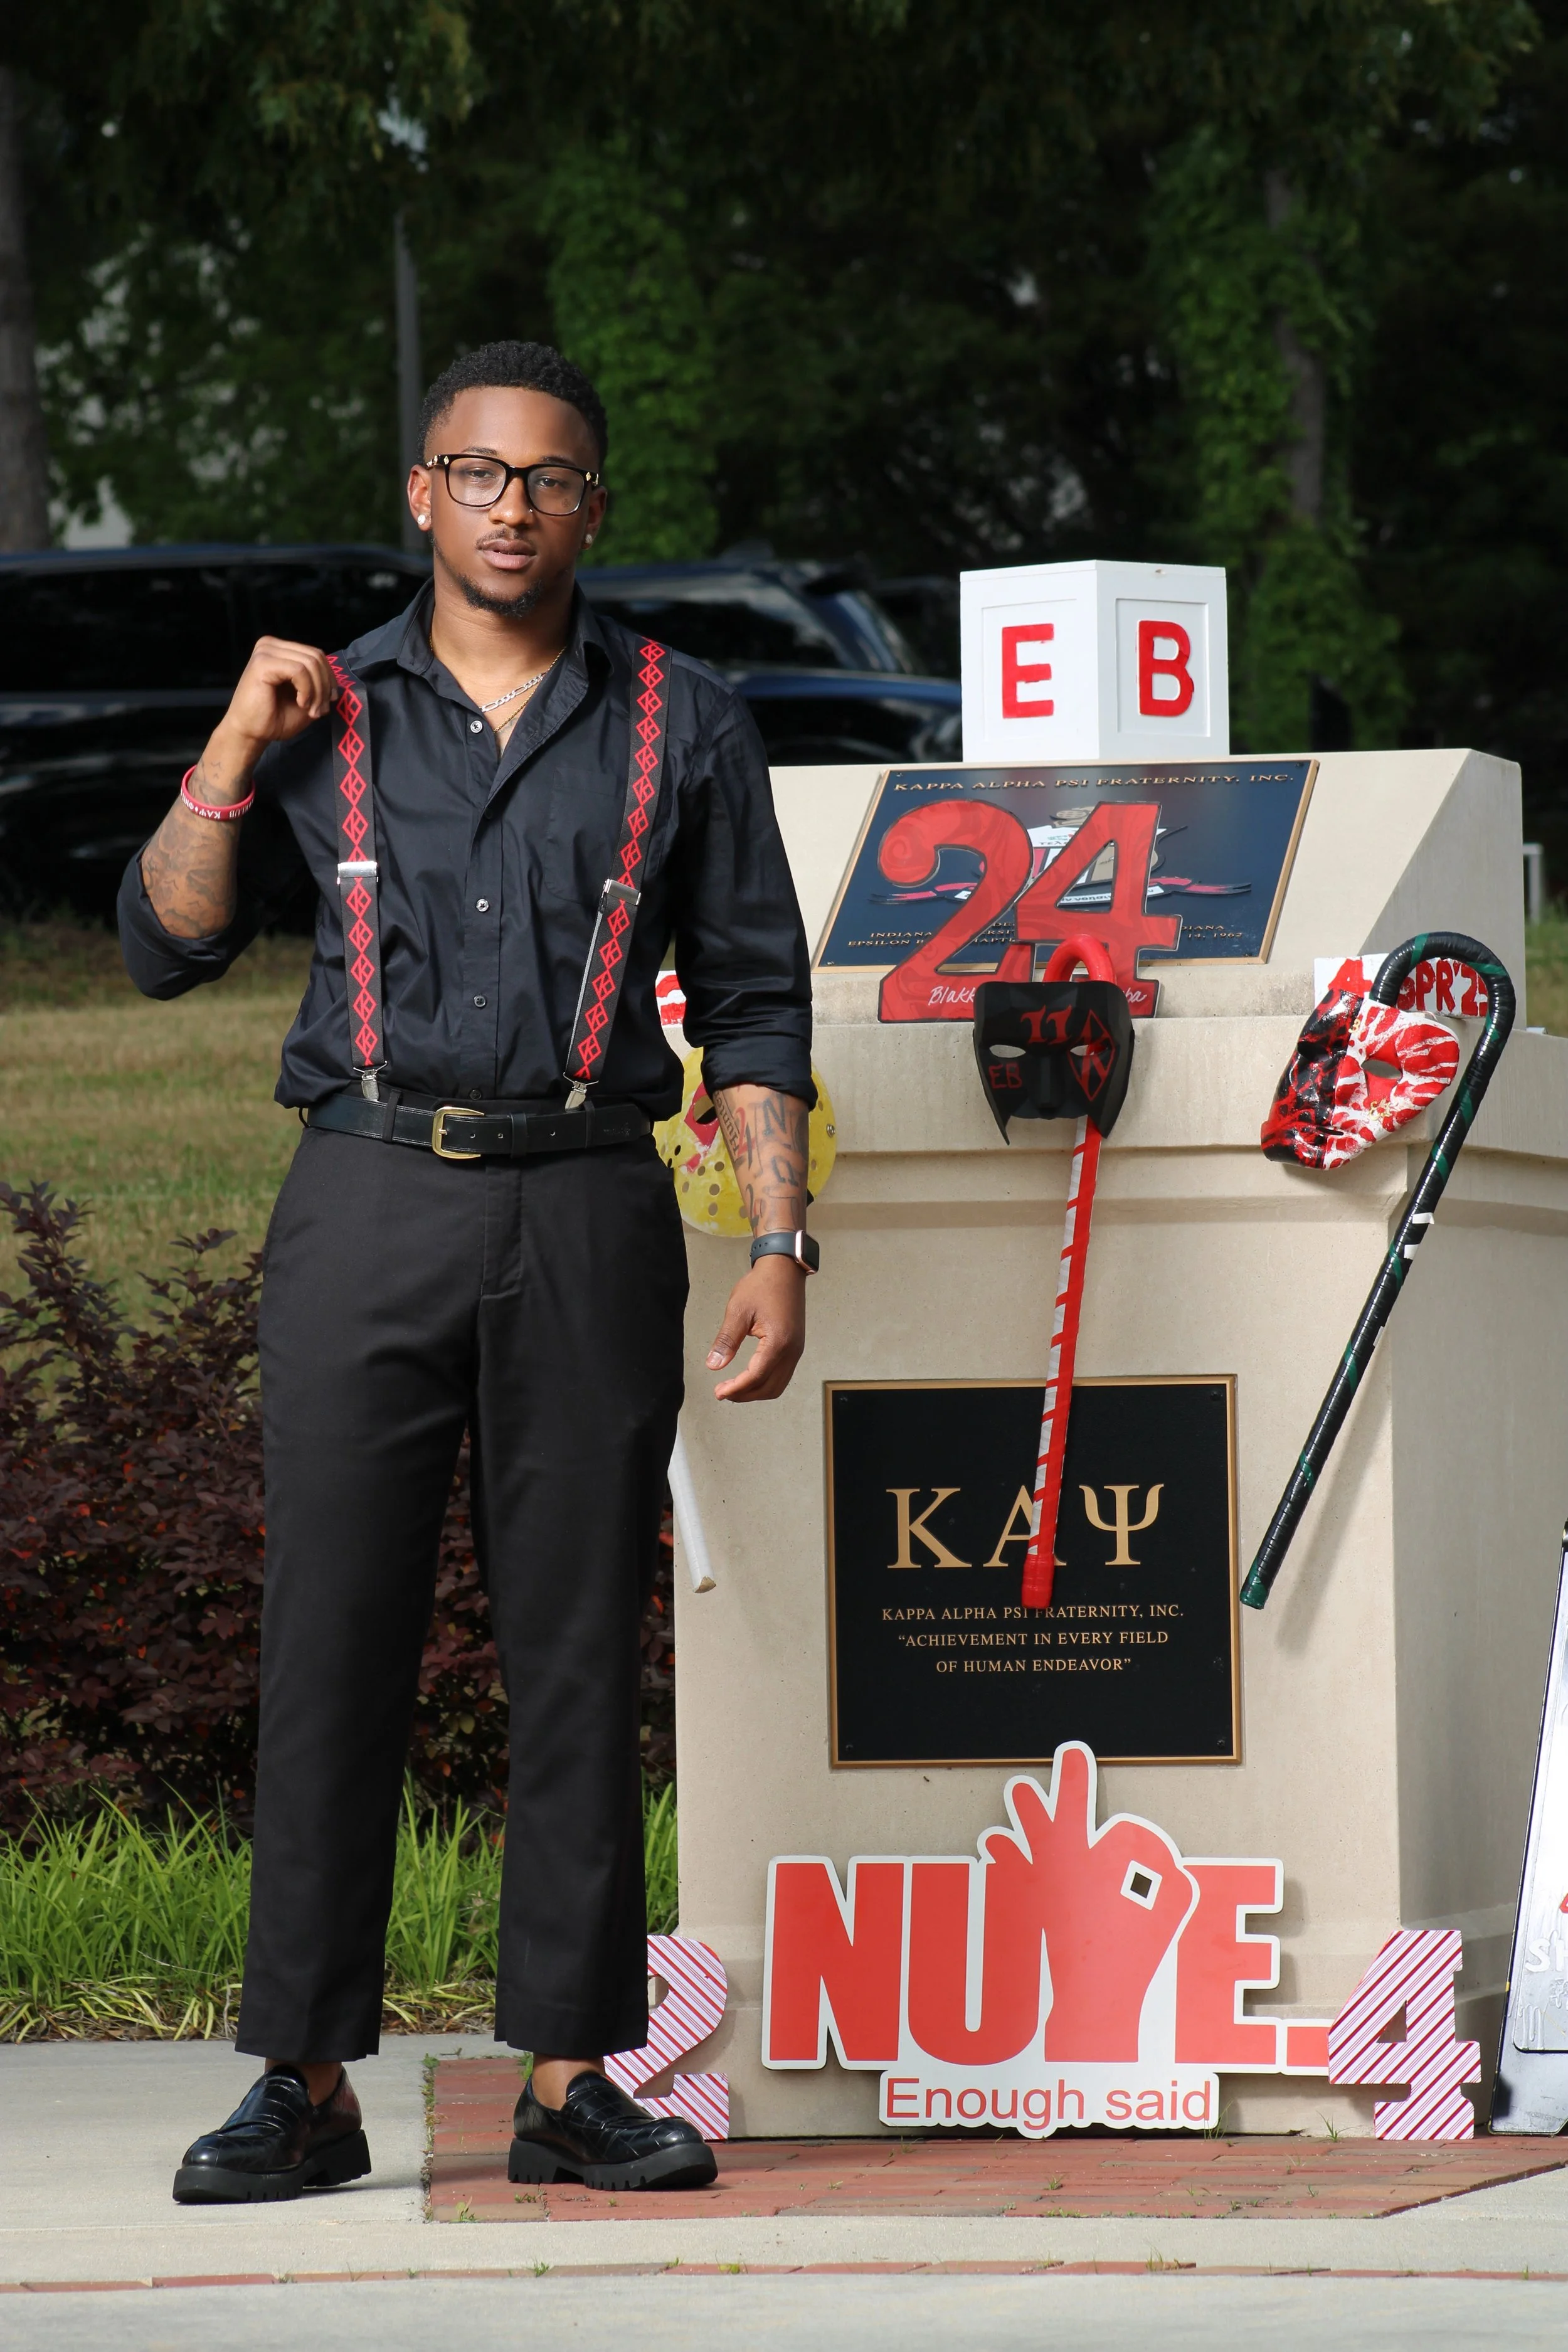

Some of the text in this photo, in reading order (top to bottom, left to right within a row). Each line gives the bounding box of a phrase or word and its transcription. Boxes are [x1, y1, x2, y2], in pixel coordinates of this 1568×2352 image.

[1002, 622, 1054, 719] E
[1138, 620, 1195, 718] B
[894, 782, 965, 791] KAPPA
[972, 780, 1046, 789] ALPHA
[1054, 779, 1089, 788] PSI
[1250, 773, 1295, 782] INC.
[877, 799, 1182, 1022] 24
[988, 1062, 1022, 1089] EB
[882, 1604, 1184, 1621] KAPPA ALPHA PSI FRATERNITY, INC.
[1034, 1633, 1052, 1645] IN
[1057, 1632, 1113, 1645] EVERY
[1119, 1631, 1169, 1644] FIELD
[936, 1661, 958, 1673] OF
[963, 1660, 1026, 1673] HUMAN
[1328, 1930, 1481, 2140] 4
[886, 2077, 1210, 2131] Enough said
